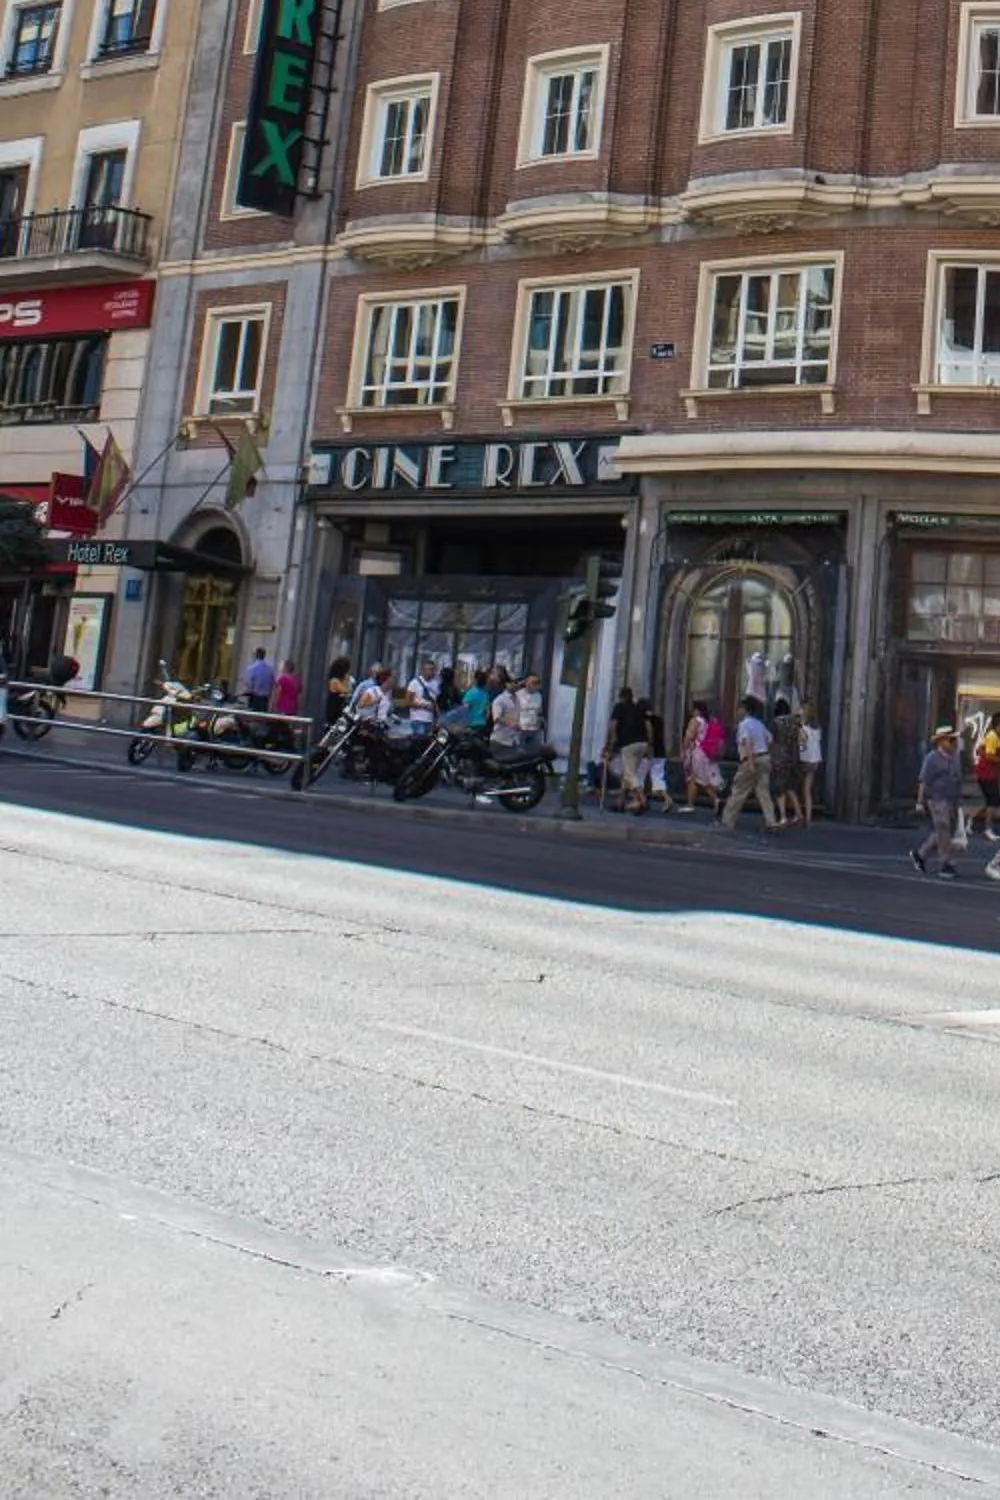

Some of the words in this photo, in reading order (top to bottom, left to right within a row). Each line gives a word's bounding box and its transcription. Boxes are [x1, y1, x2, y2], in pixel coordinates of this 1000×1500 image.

[340, 445, 456, 492] CINE
[482, 441, 587, 489] REX
[67, 542, 101, 561] Hotel
[104, 543, 129, 563] Rex
